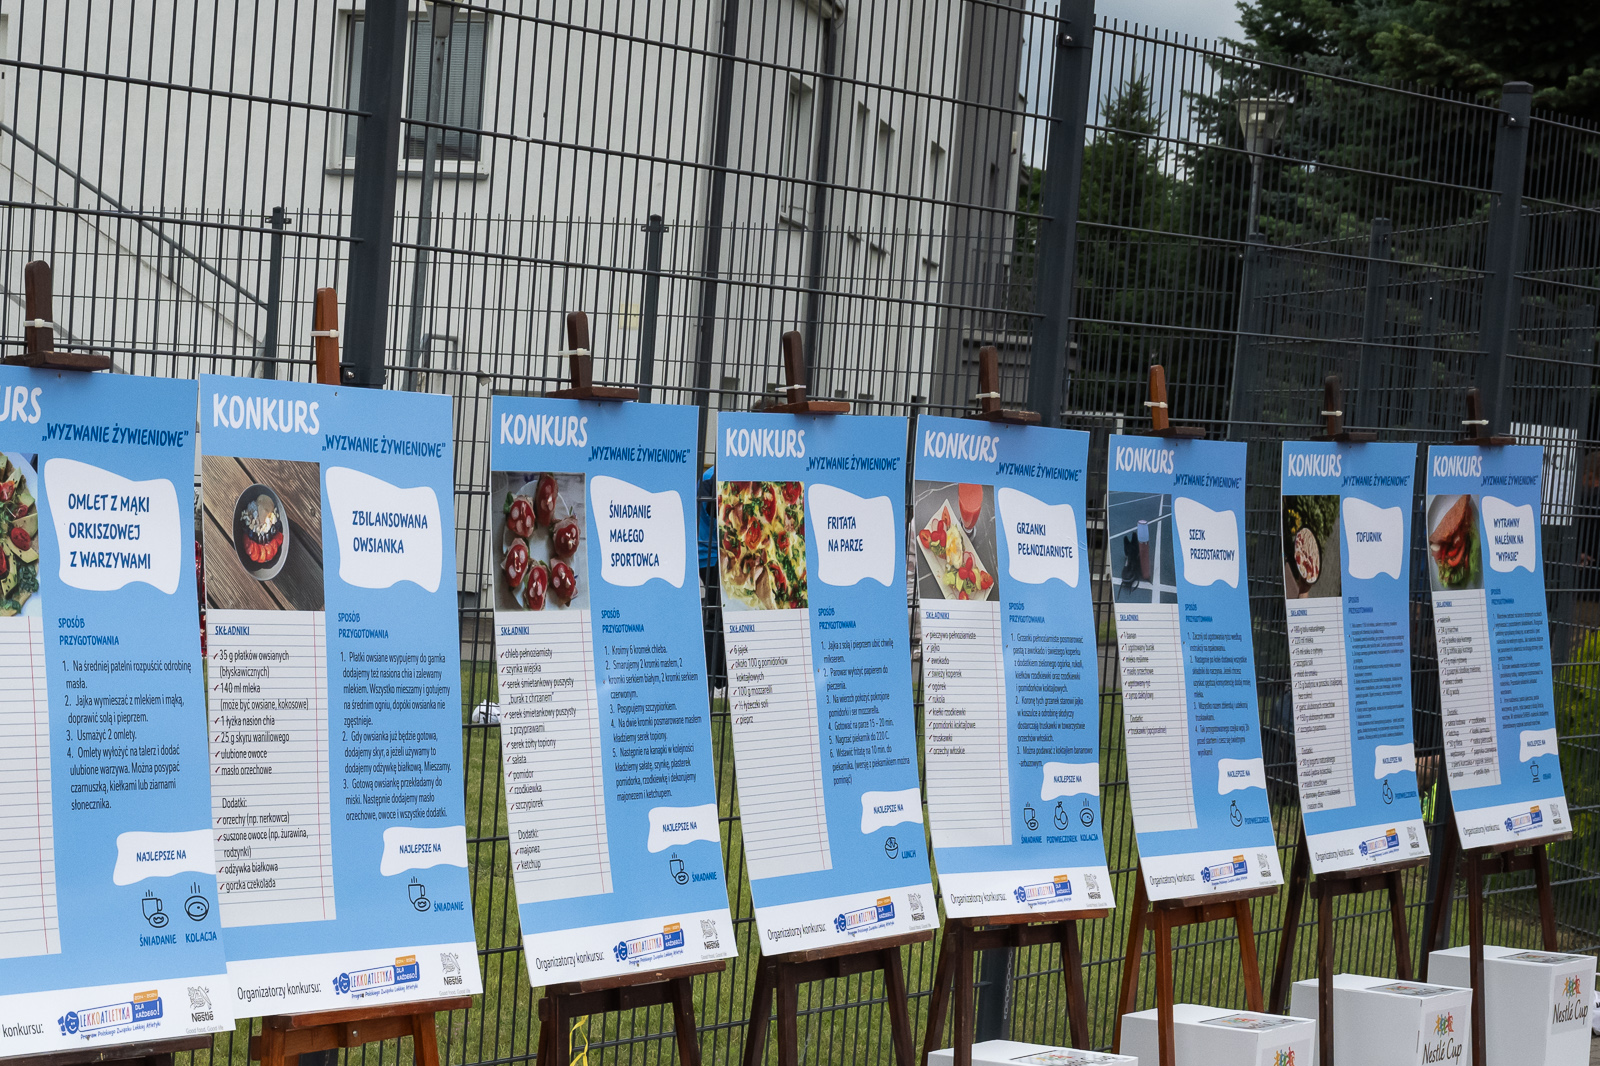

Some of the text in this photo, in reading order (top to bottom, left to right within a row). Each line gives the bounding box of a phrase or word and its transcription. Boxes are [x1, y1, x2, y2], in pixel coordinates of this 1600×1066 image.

[213, 393, 320, 435] KONKURS
[500, 412, 588, 447] KONKURS
[726, 428, 805, 458] KONKURS
[924, 430, 999, 463] KONKURS
[1115, 446, 1174, 474] KONKURS
[1288, 454, 1342, 477] KONKURS
[1433, 455, 1482, 477] KONKURS
[68, 494, 150, 516] OMLET Z MĄKI
[610, 501, 651, 519] ŚNIADANIE
[352, 510, 428, 529] ZBILANSOWANA
[828, 517, 856, 529] FRITATA
[1494, 518, 1520, 528] WYTRAWNY
[69, 523, 140, 540] ORKISZOWEJ
[610, 529, 644, 543] MAŁEGO
[1017, 523, 1046, 536] GRZANKI
[1189, 529, 1205, 540] SZEJK
[1356, 532, 1382, 542] TOFURNIK
[353, 537, 404, 554] OWSIANKA
[828, 539, 863, 552] NA PARZE
[1495, 532, 1523, 545] NALEŚNIK NA
[1018, 543, 1073, 558] PEŁNOZIARNISTE
[1190, 548, 1235, 561] PRZEDSTARTOWY
[70, 552, 150, 569] Z WARZYWAMI
[611, 553, 659, 567] SPORTOWCA
[434, 901, 464, 912] ŚNIADANIE
[139, 931, 217, 947] ŚNIADANIE KOLACJA
[1553, 1000, 1588, 1025] Nestlé Cup
[2, 1022, 44, 1037] konkursu:
[1422, 1038, 1462, 1065] Nestlé Cup
